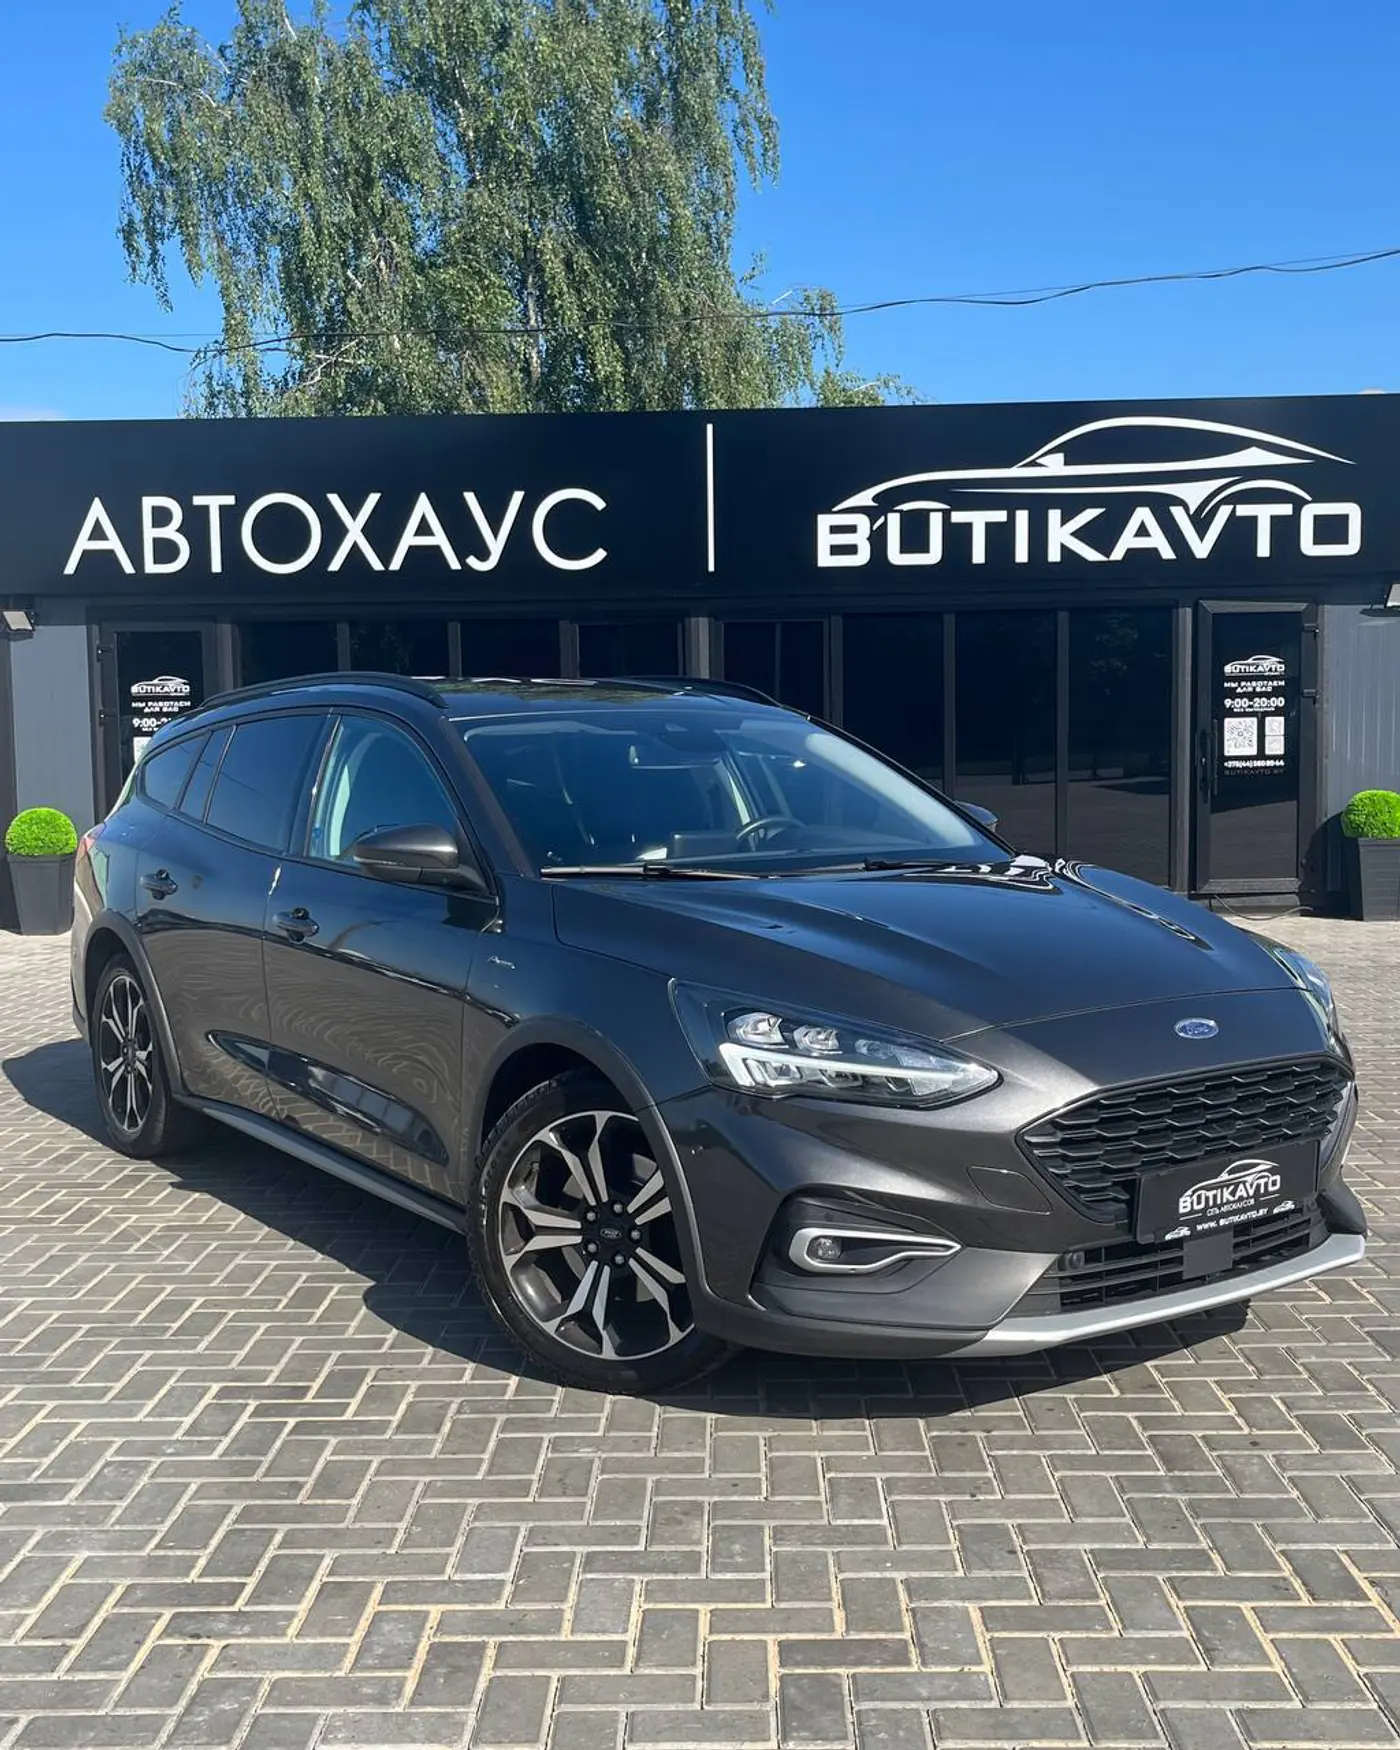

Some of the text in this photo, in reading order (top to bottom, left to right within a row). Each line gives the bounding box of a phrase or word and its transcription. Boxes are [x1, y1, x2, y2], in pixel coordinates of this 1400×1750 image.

[63, 488, 608, 575] АВТОХАУС
[816, 501, 1362, 568] BUTIKAVTO
[1224, 697, 1285, 708] 9:00-20:00
[1179, 1175, 1281, 1214] BUTIKAVTO
